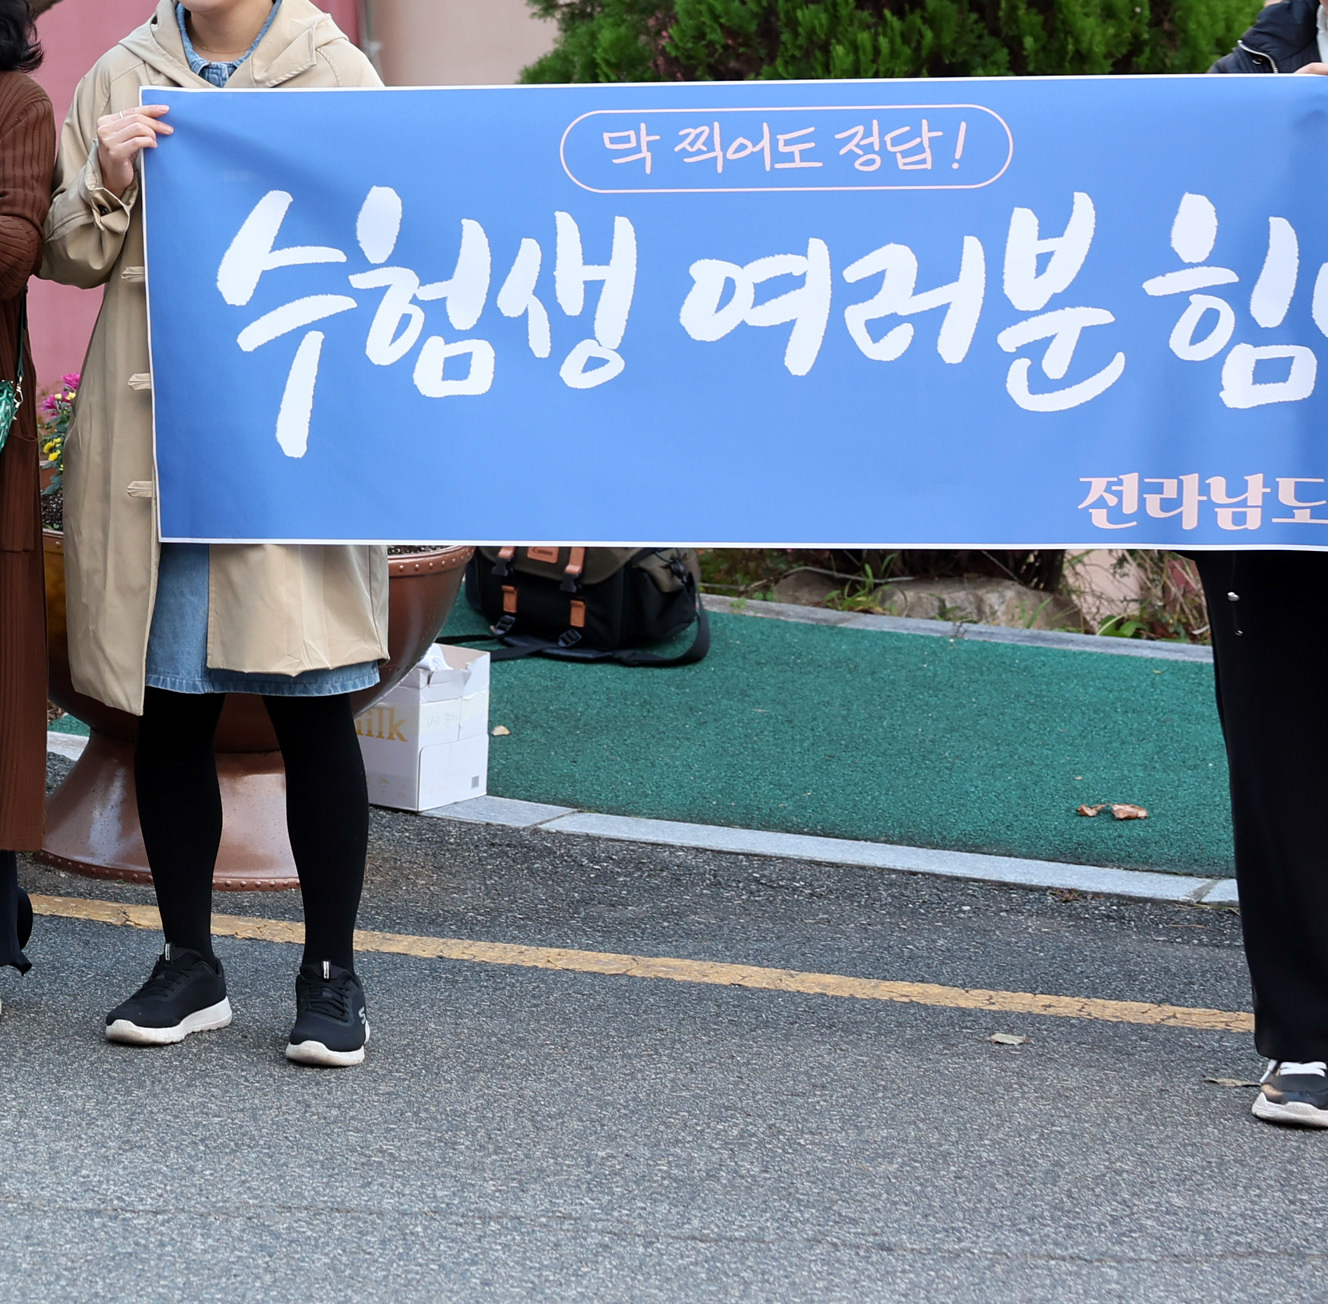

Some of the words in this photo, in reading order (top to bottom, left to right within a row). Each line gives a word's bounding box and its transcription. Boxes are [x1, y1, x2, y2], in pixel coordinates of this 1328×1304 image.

[603, 122, 661, 175] 막
[674, 121, 824, 174] 찍어도
[216, 185, 638, 458] 수험생
[679, 191, 1126, 412] 여러분
[1142, 192, 1328, 410] 힘
[1077, 472, 1328, 531] 전라남도
